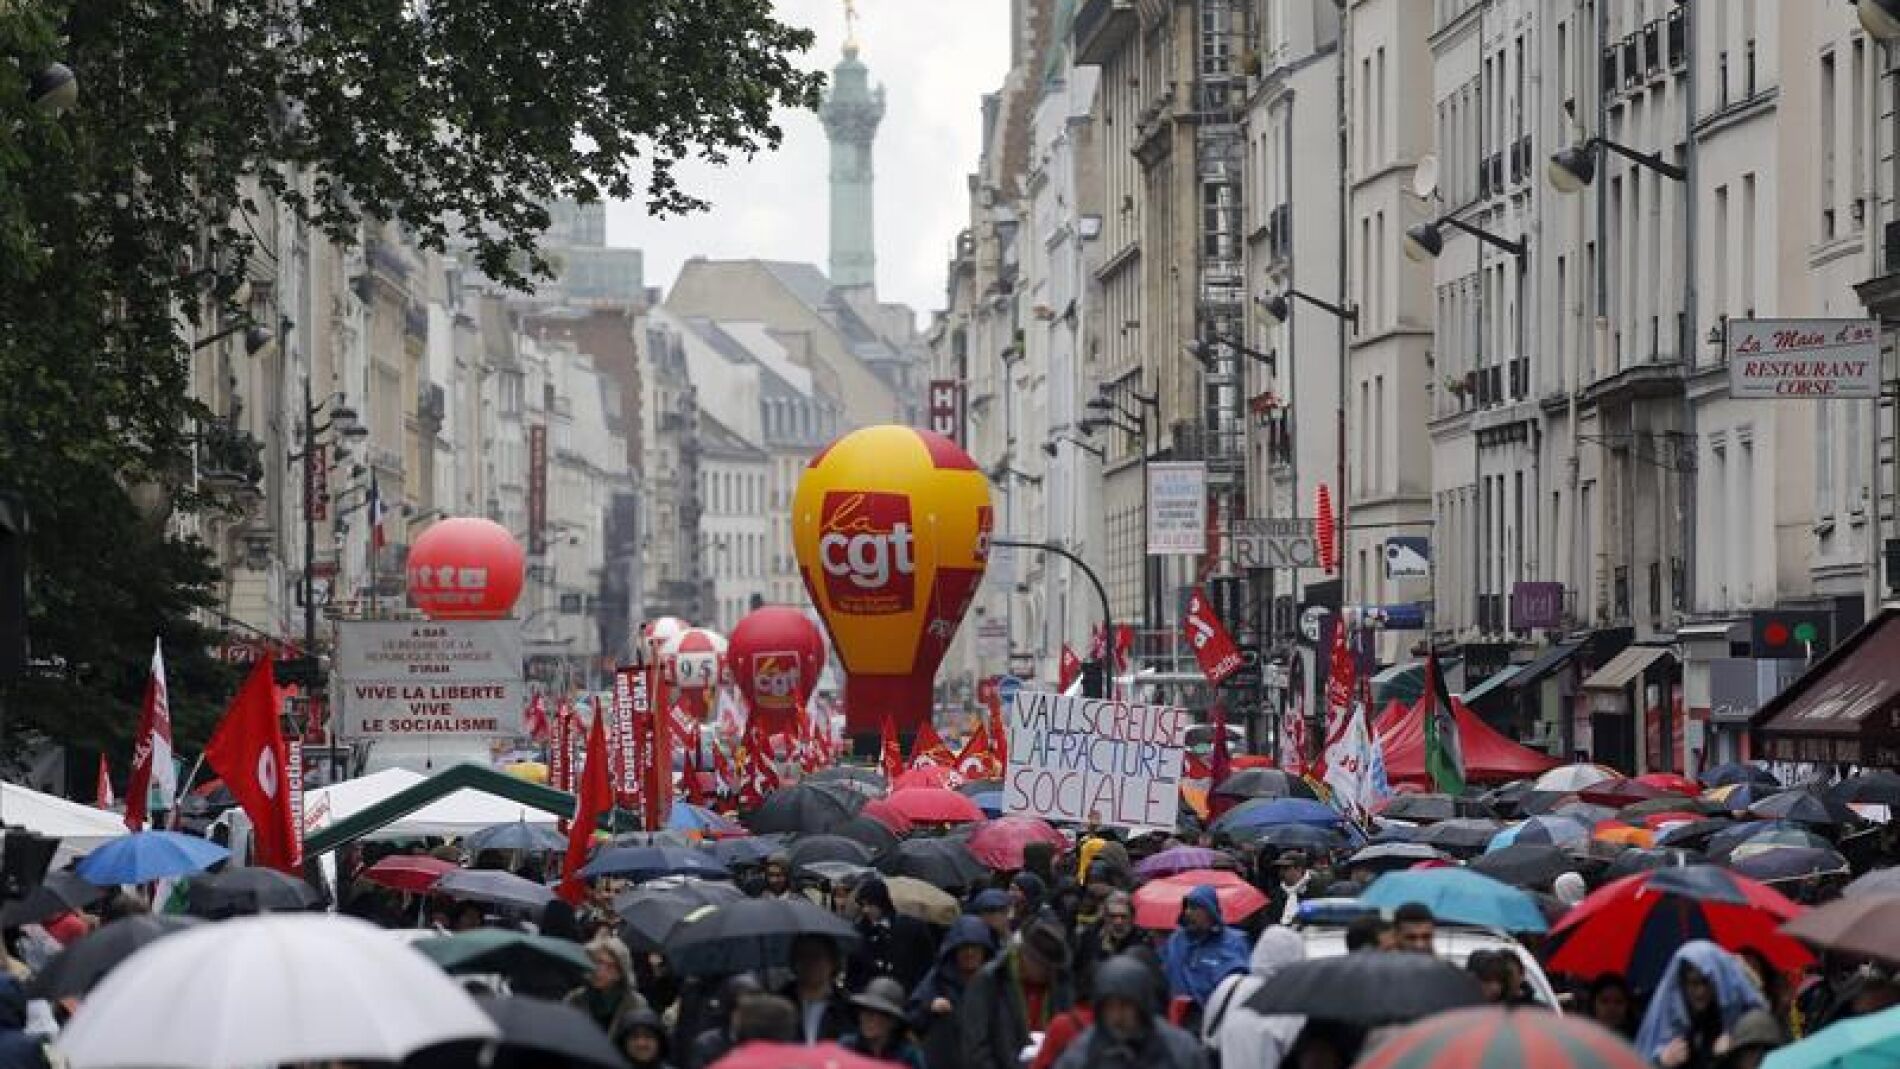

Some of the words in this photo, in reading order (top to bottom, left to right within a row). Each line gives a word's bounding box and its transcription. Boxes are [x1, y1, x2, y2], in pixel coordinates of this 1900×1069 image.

[1773, 328, 1824, 348] Main
[1744, 361, 1868, 377] RESTAURANT
[1776, 379, 1837, 393] CORSE
[820, 523, 915, 588] cgt
[355, 685, 397, 699] VIVE
[403, 685, 425, 699] LA
[431, 685, 505, 699] LIBERTE
[410, 702, 452, 716] VIVE
[362, 719, 383, 732] LE
[389, 719, 497, 732] SOCIALISME
[1009, 769, 1175, 827] SOCIALE
